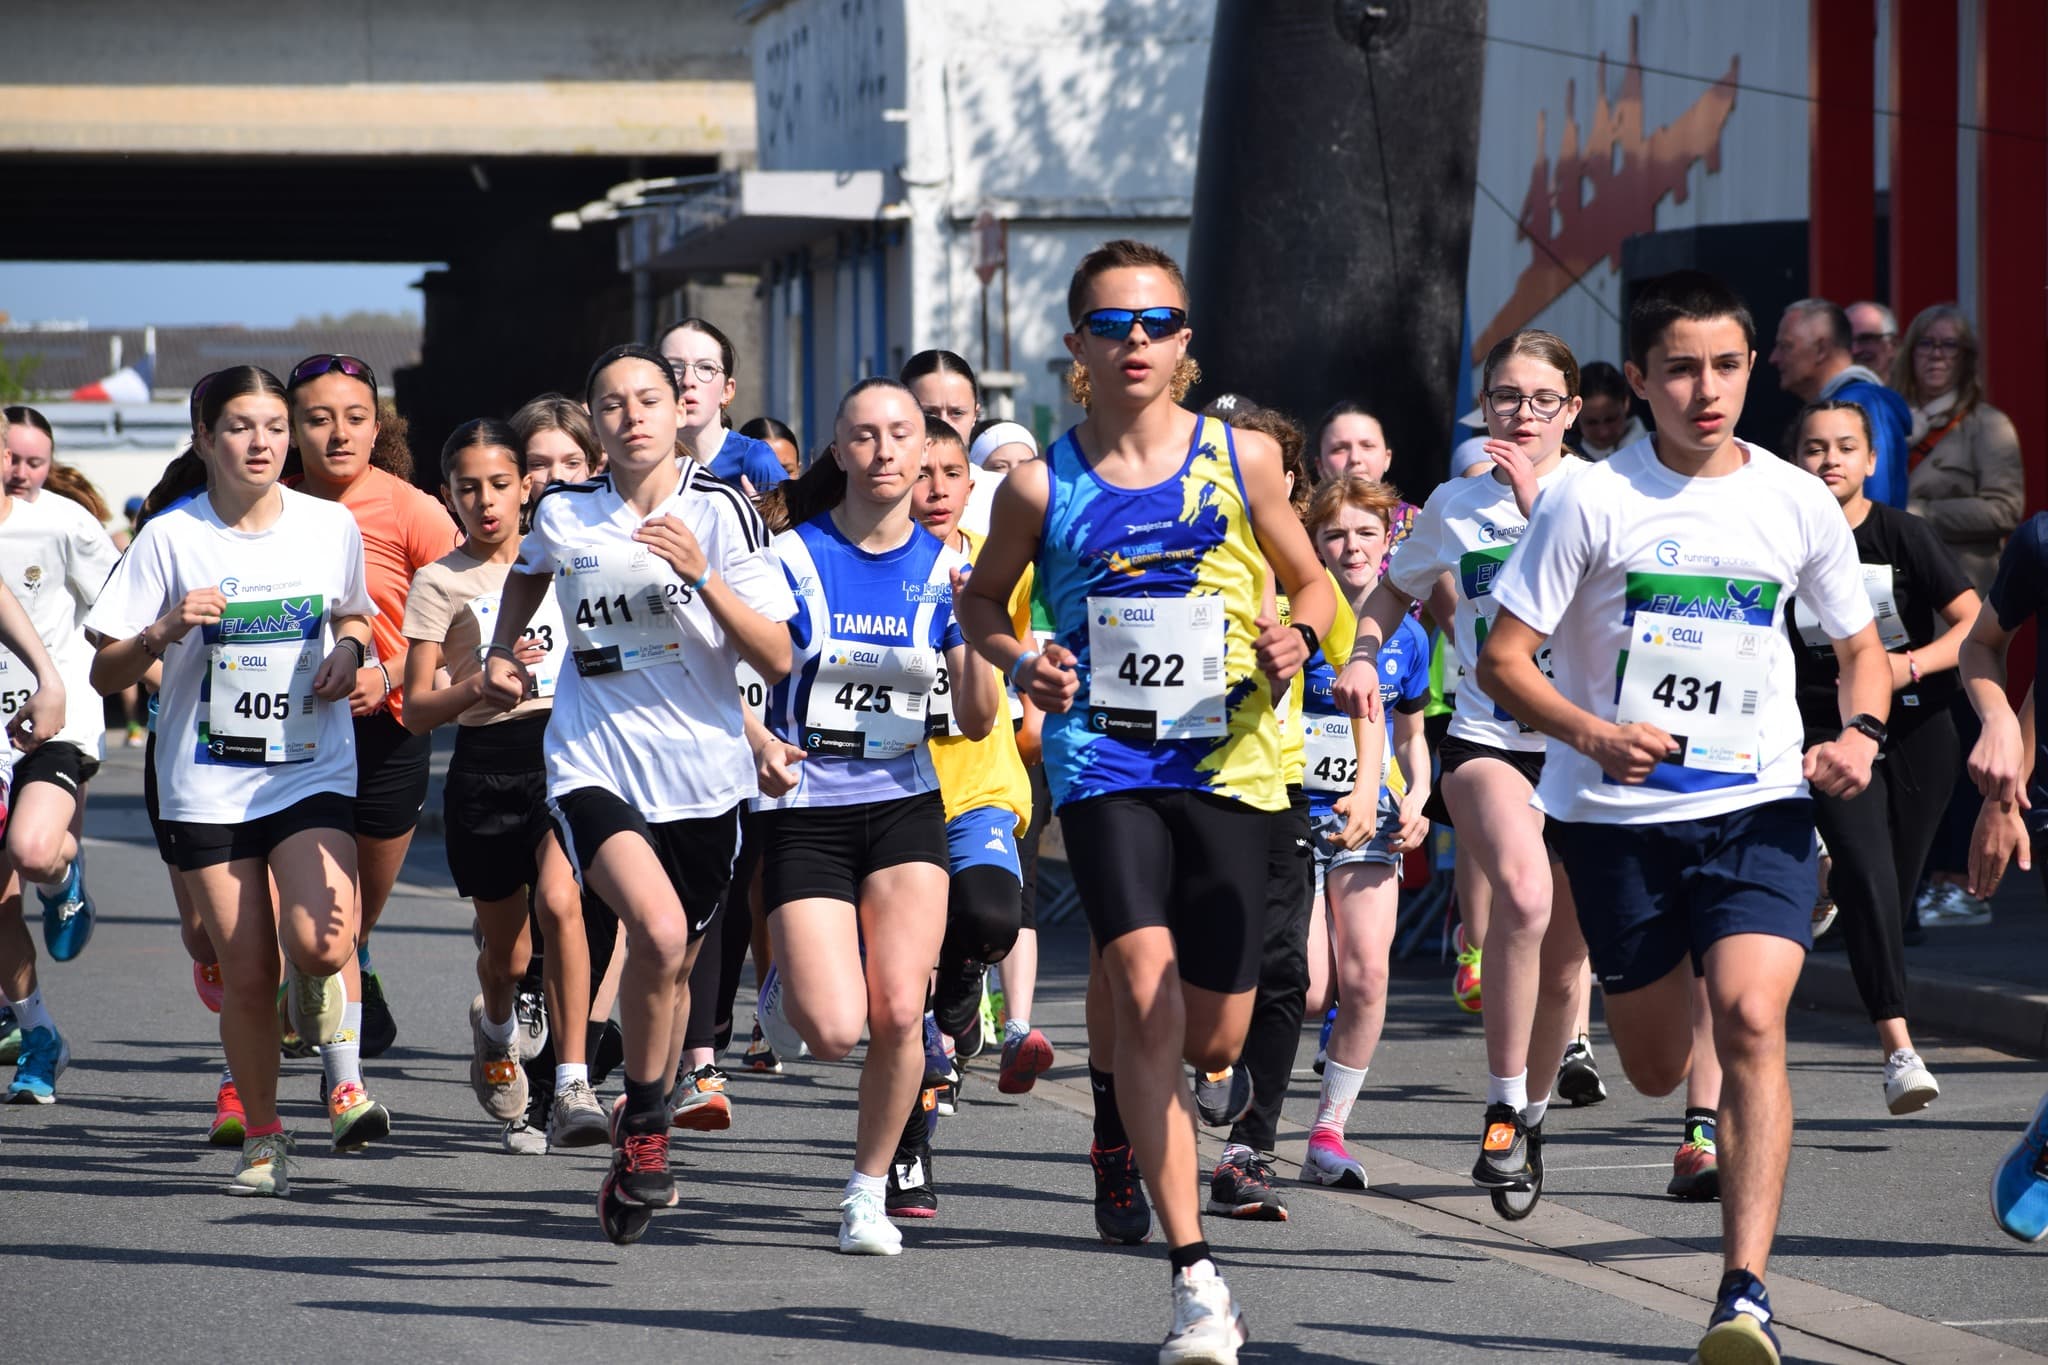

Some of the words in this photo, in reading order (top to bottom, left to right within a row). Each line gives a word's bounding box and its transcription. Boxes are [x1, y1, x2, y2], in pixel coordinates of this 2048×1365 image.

[1217, 395, 1237, 409] NY
[1497, 525, 1525, 536] running
[665, 584, 692, 605] es
[903, 581, 920, 592] Les
[575, 593, 633, 628] 411
[1119, 608, 1155, 621] l'eau
[1648, 594, 1730, 620] ELAN
[219, 615, 287, 634] ELAN
[833, 613, 908, 637] TAMARA
[1667, 626, 1703, 644] l'eau
[850, 649, 879, 664] l'eau
[933, 667, 949, 695] 3
[1117, 652, 1185, 687] 422
[234, 691, 290, 720] 405
[835, 682, 893, 713] 425
[1652, 673, 1723, 715] 431
[1313, 756, 1358, 783] 432
